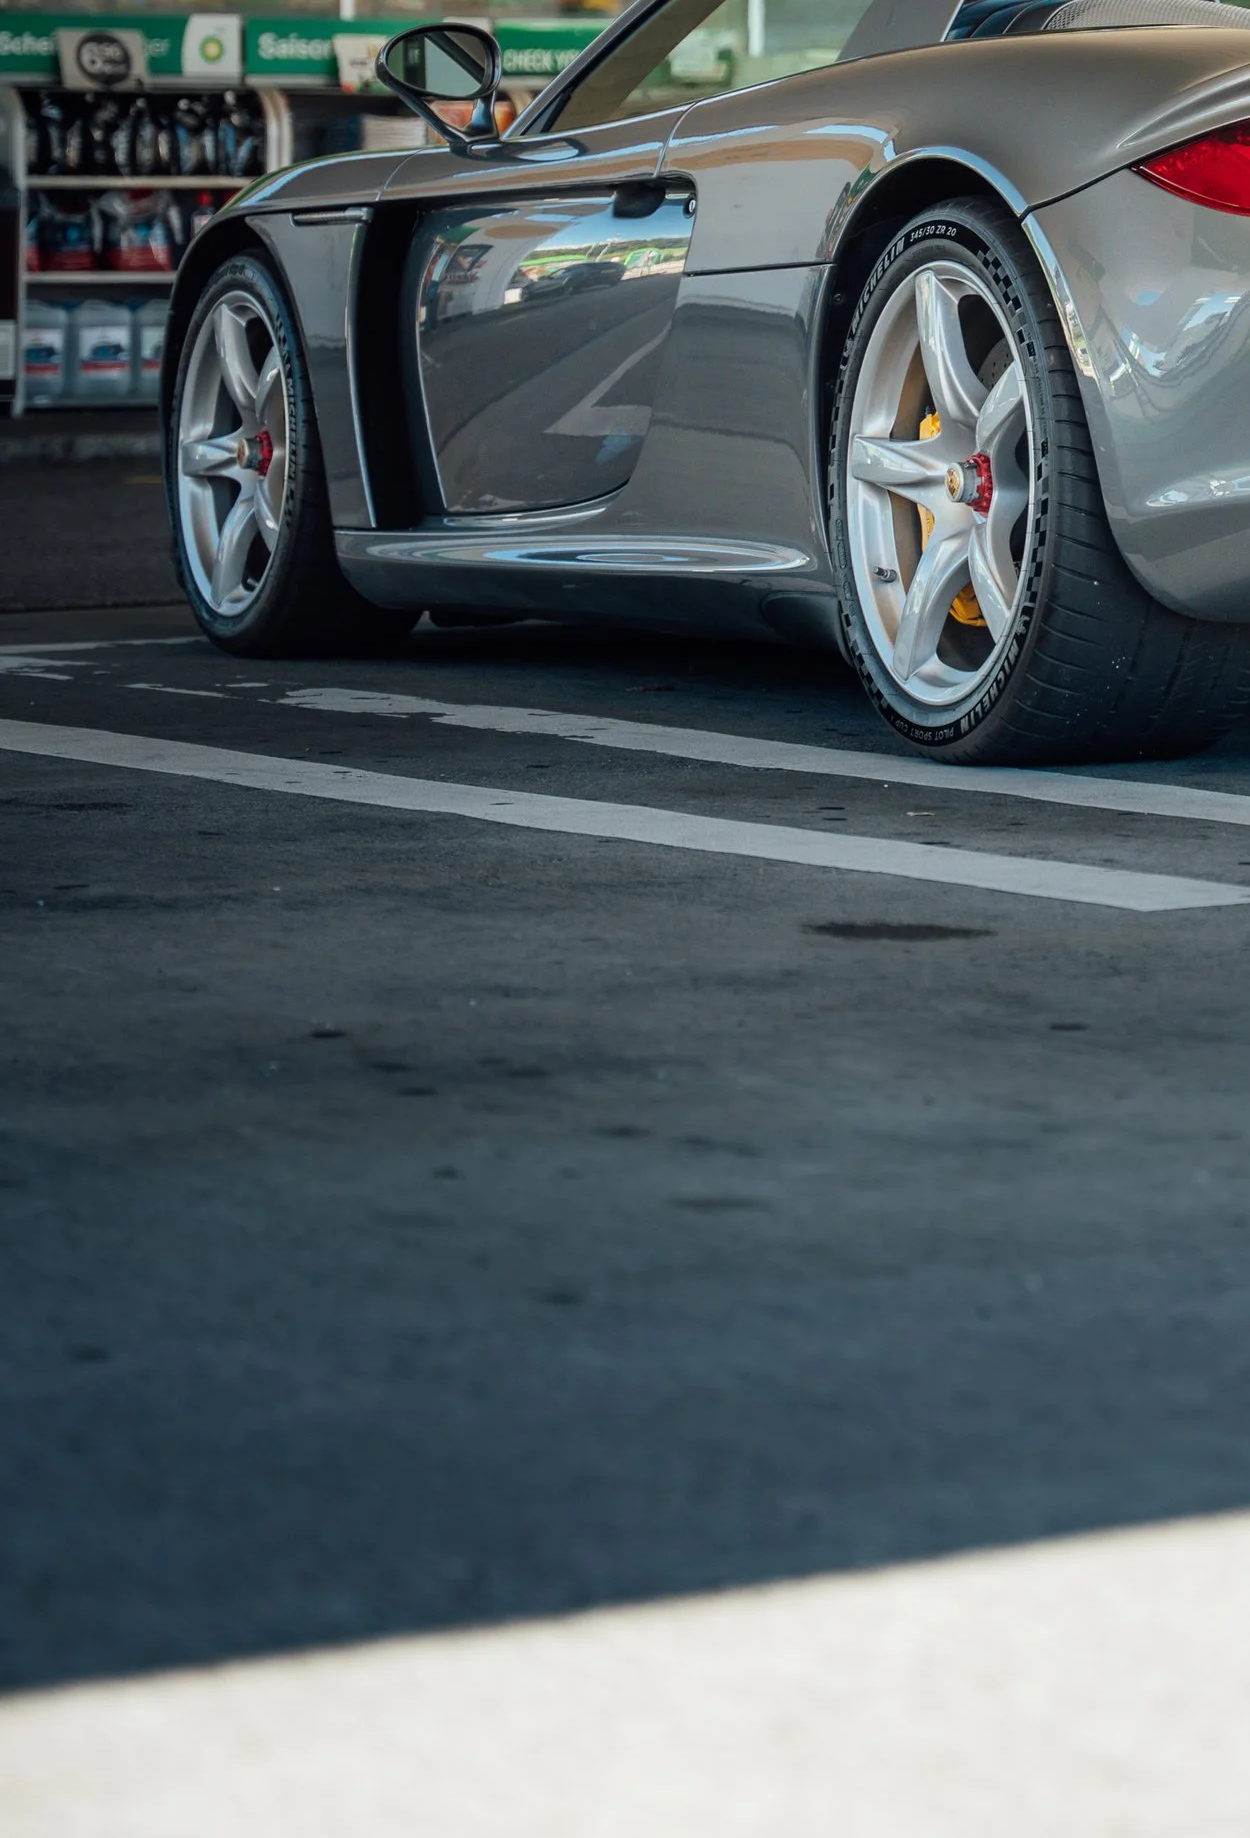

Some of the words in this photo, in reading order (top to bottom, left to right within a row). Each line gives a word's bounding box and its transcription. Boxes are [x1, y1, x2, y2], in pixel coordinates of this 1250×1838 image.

[503, 48, 552, 73] CHECK
[851, 236, 906, 335] MICHELIN
[909, 225, 935, 242] 345/30
[935, 224, 946, 235] ZR
[946, 226, 957, 237] 20
[286, 378, 296, 479] MICHELIN
[960, 638, 1020, 734] MICHELIN
[895, 719, 909, 733] CUP
[909, 726, 933, 741] SPORT
[934, 725, 955, 741] PILOT
